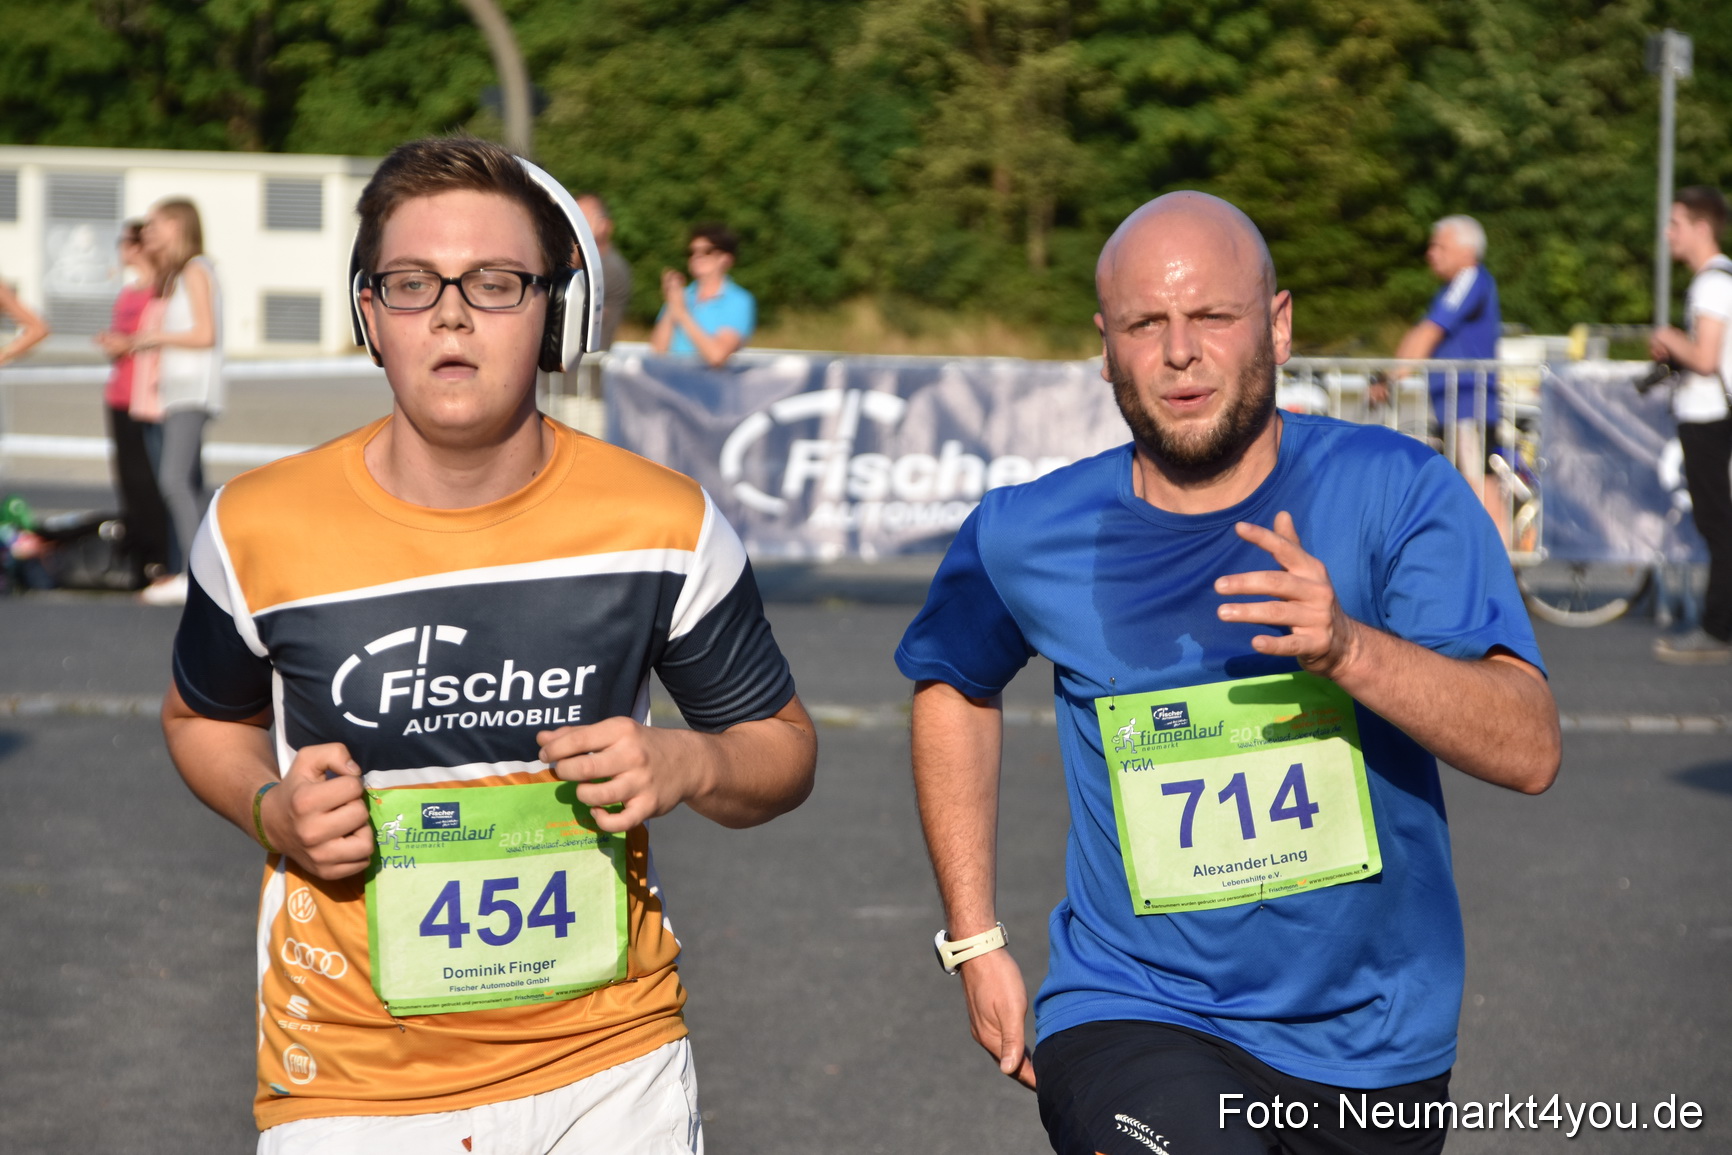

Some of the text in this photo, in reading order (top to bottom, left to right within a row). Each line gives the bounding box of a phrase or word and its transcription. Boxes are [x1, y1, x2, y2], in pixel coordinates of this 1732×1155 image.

[378, 659, 597, 714] Fischer
[402, 704, 582, 736] AUTOMOBILE
[1139, 720, 1275, 746] firmenlauf 2015
[1141, 742, 1179, 752] neumarkt
[1160, 762, 1320, 849] 714
[405, 823, 496, 843] firmenlauf
[498, 829, 545, 848] 2015
[405, 841, 445, 849] neumarkt
[1193, 849, 1308, 878] Alexander Lang
[1222, 871, 1283, 888] Lebenshilfe e.V.
[419, 869, 576, 949] 454
[443, 958, 557, 980] Dominik Finger
[449, 976, 550, 992] Fischer Automobile GmbH
[277, 1019, 322, 1033] SEAT
[289, 1053, 309, 1075] FIAT
